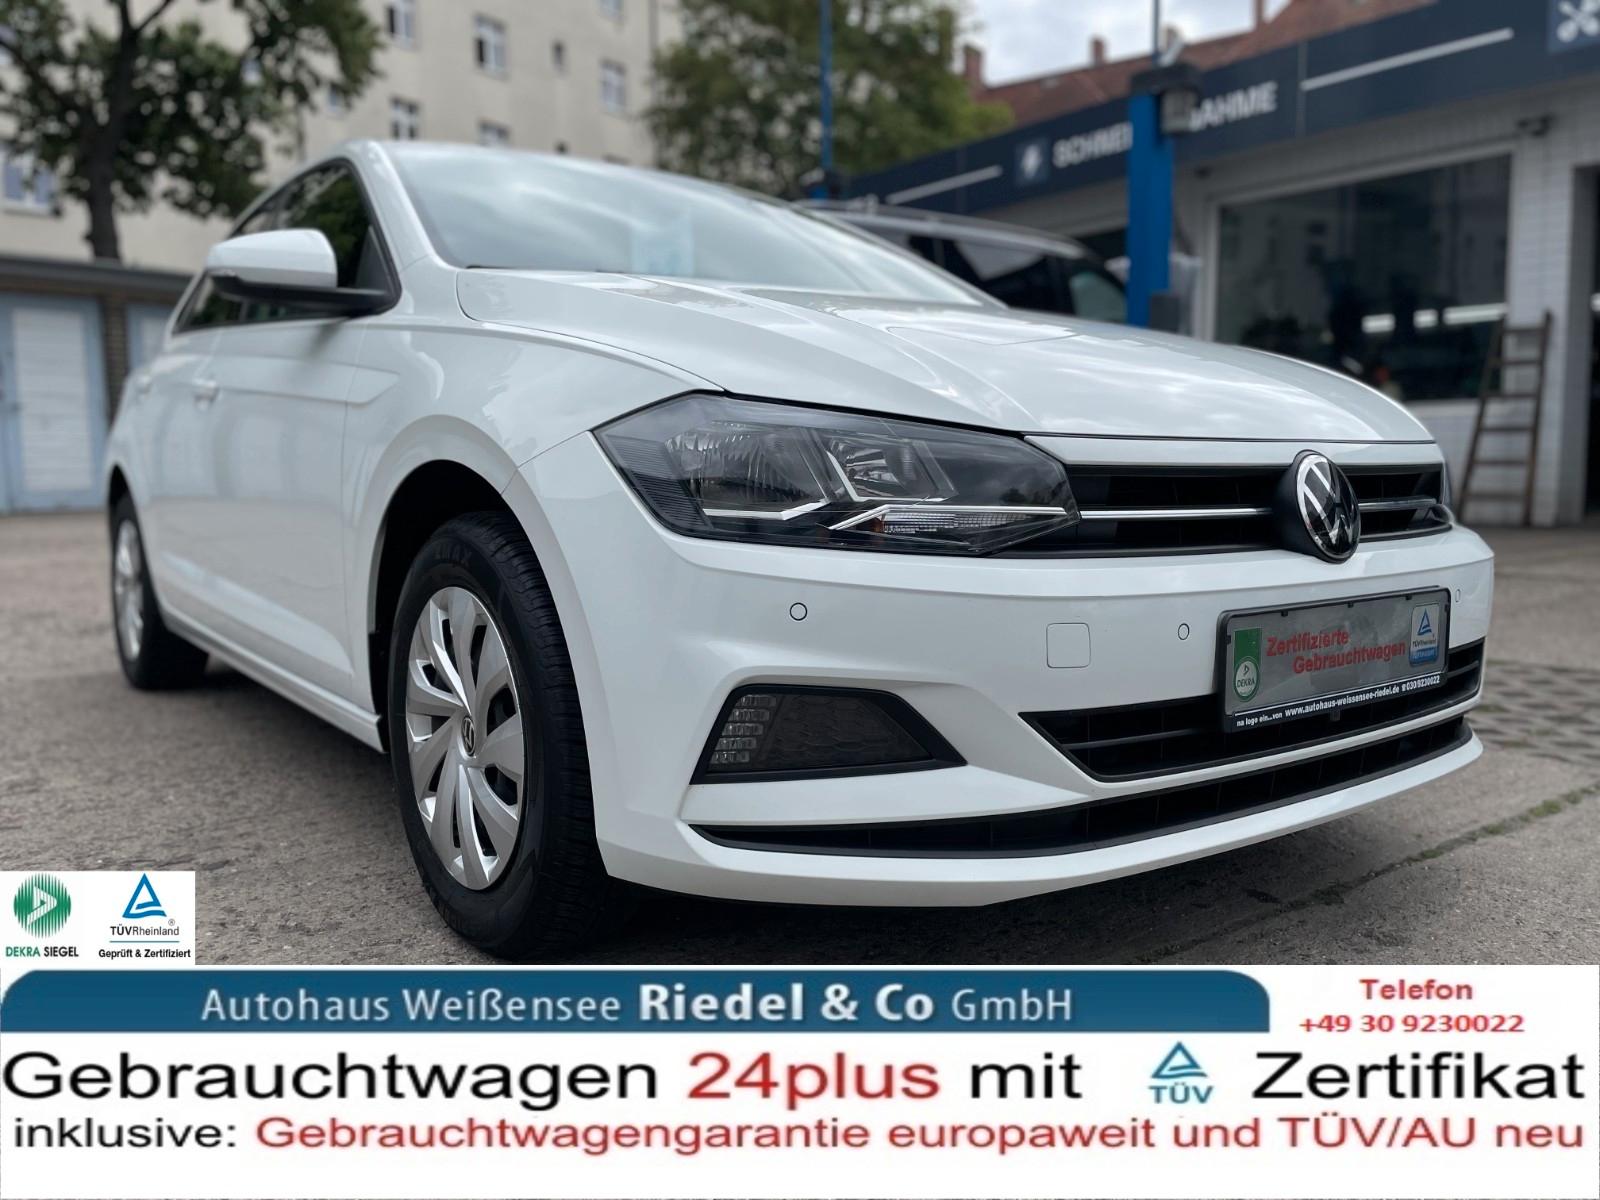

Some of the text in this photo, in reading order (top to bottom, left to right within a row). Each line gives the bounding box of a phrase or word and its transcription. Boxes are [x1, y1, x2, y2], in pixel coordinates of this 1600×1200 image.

[1266, 629, 1349, 657] Zertifizierte
[1293, 641, 1406, 673] Gebrauchtwagen
[1237, 678, 1255, 688] DEKRA
[1285, 684, 1400, 718] www.autohaus-weissensee-riedel.de
